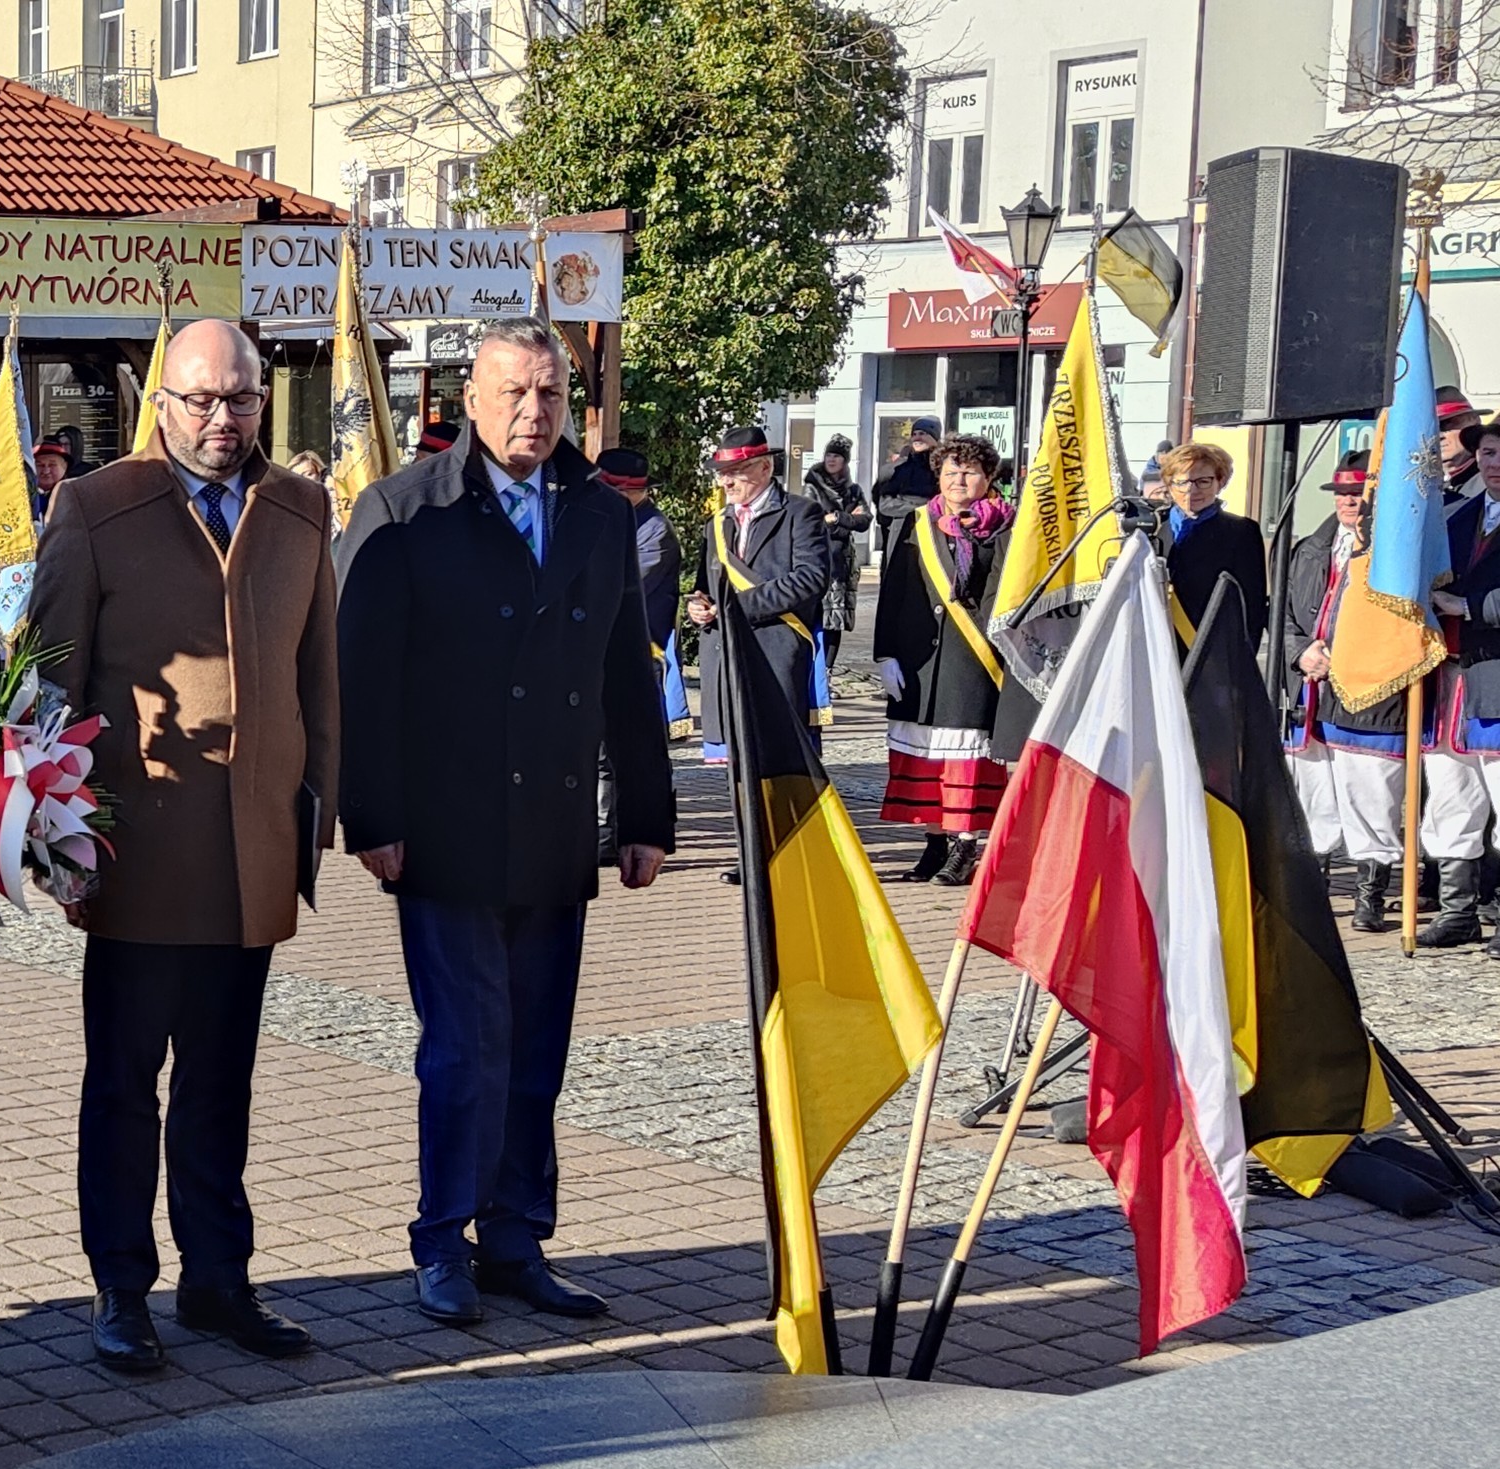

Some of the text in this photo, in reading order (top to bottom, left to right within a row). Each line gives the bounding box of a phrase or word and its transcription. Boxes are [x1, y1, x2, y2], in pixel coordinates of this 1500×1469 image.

[943, 94, 976, 109] KURS
[45, 234, 241, 267] NATURALNE
[252, 235, 532, 270] POZNJ TEN SMAK
[251, 284, 455, 316] ZAPRZAMY
[470, 288, 525, 311] Abogada
[902, 296, 1011, 329] Maxim
[970, 326, 1056, 339] SKLE NICZE
[51, 386, 82, 397] Pizza
